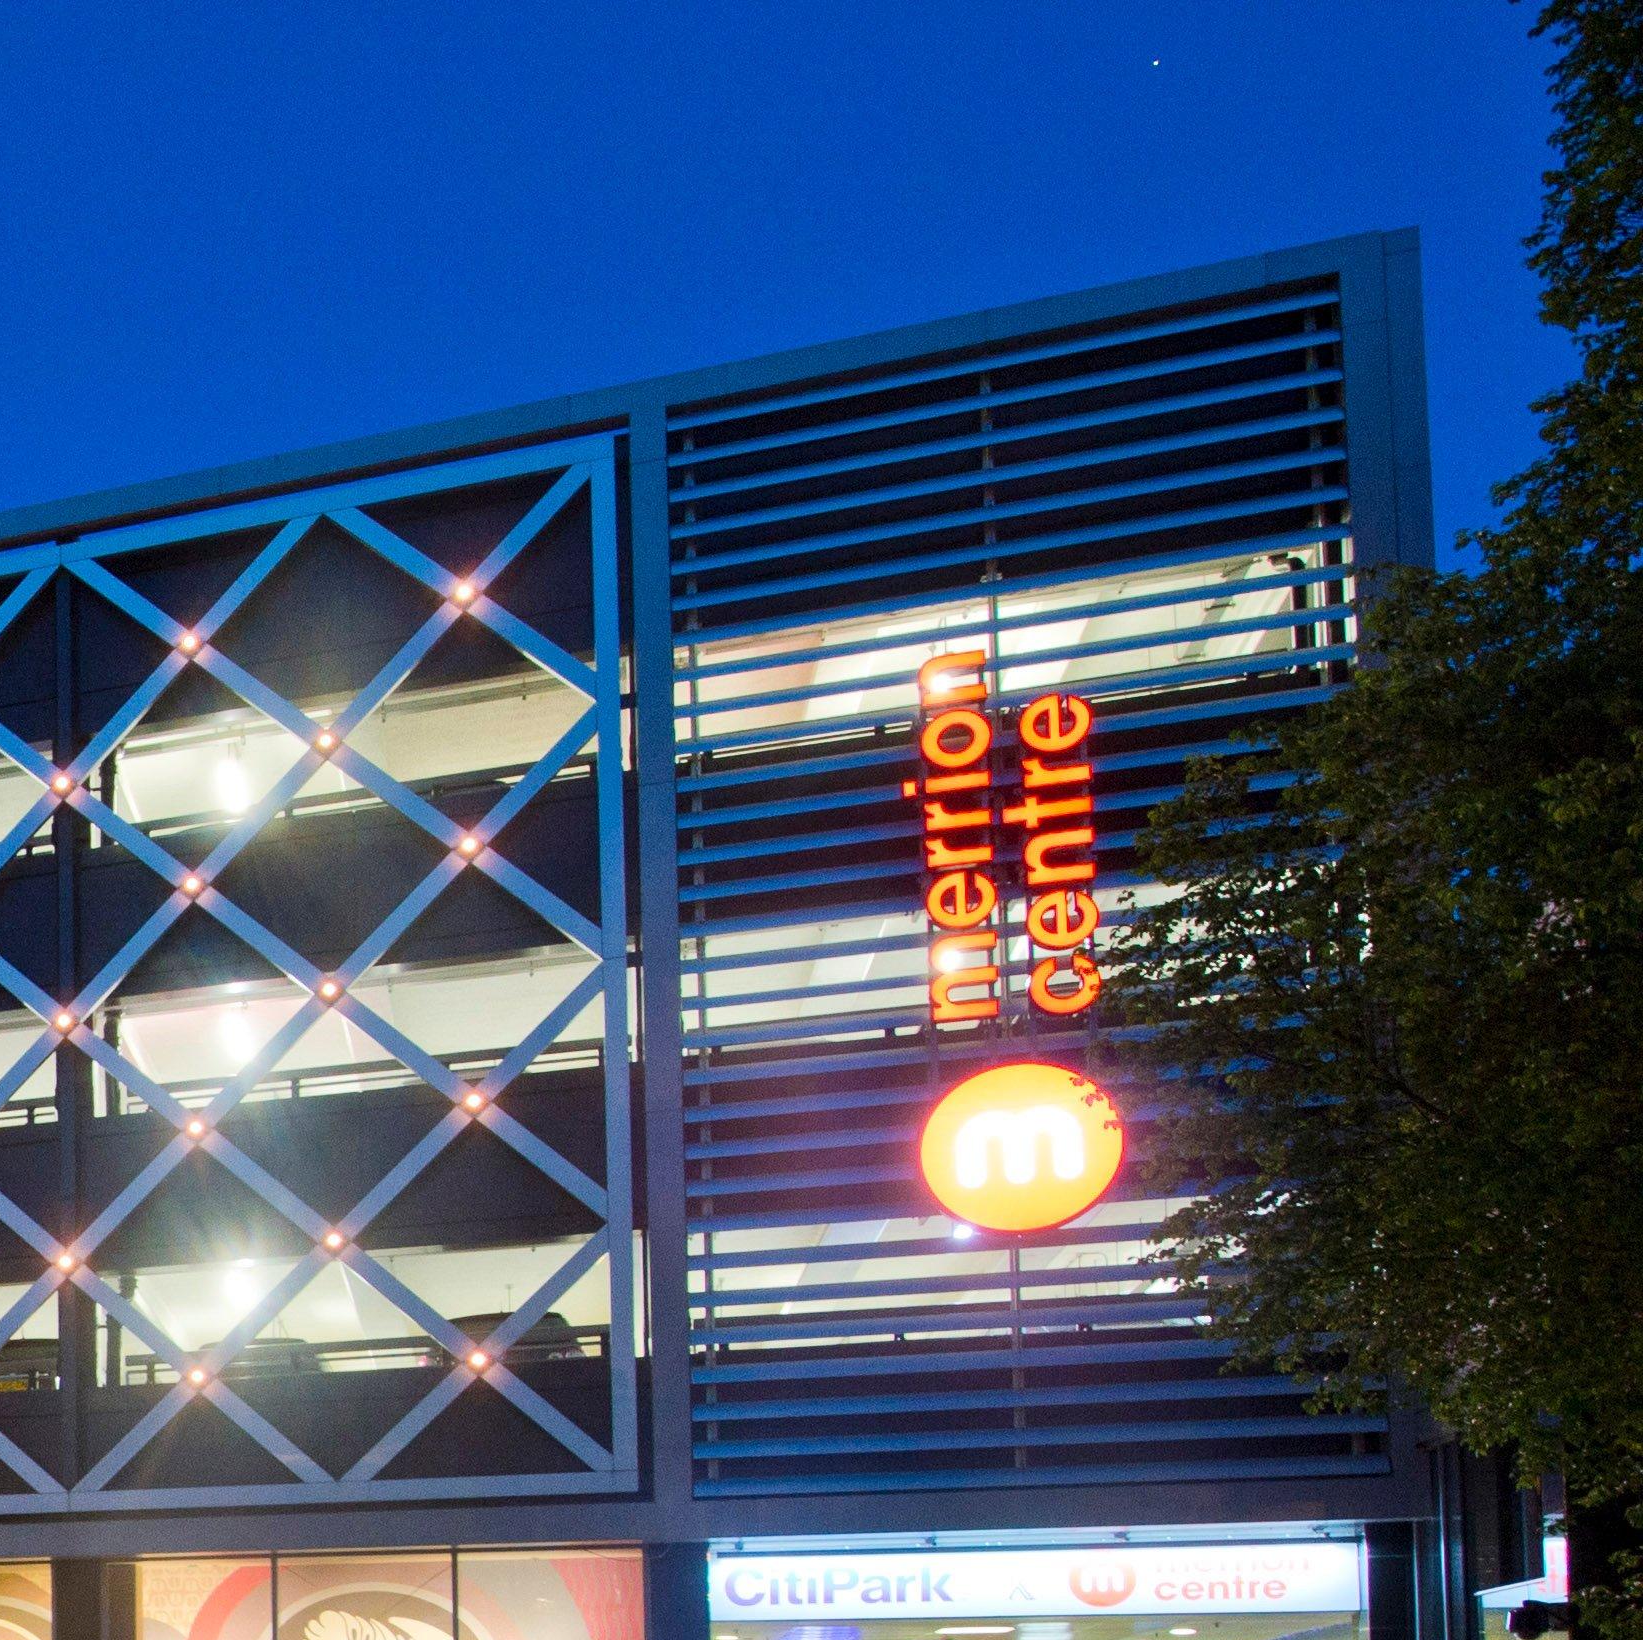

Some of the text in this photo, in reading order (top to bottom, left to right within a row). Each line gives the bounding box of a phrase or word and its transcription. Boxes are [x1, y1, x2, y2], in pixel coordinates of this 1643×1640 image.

[901, 649, 1000, 1022] merrion
[1001, 693, 1101, 1016] centre
[954, 1103, 1086, 1189] m
[724, 1567, 954, 1606] CitiPark
[1154, 1576, 1288, 1601] centre
